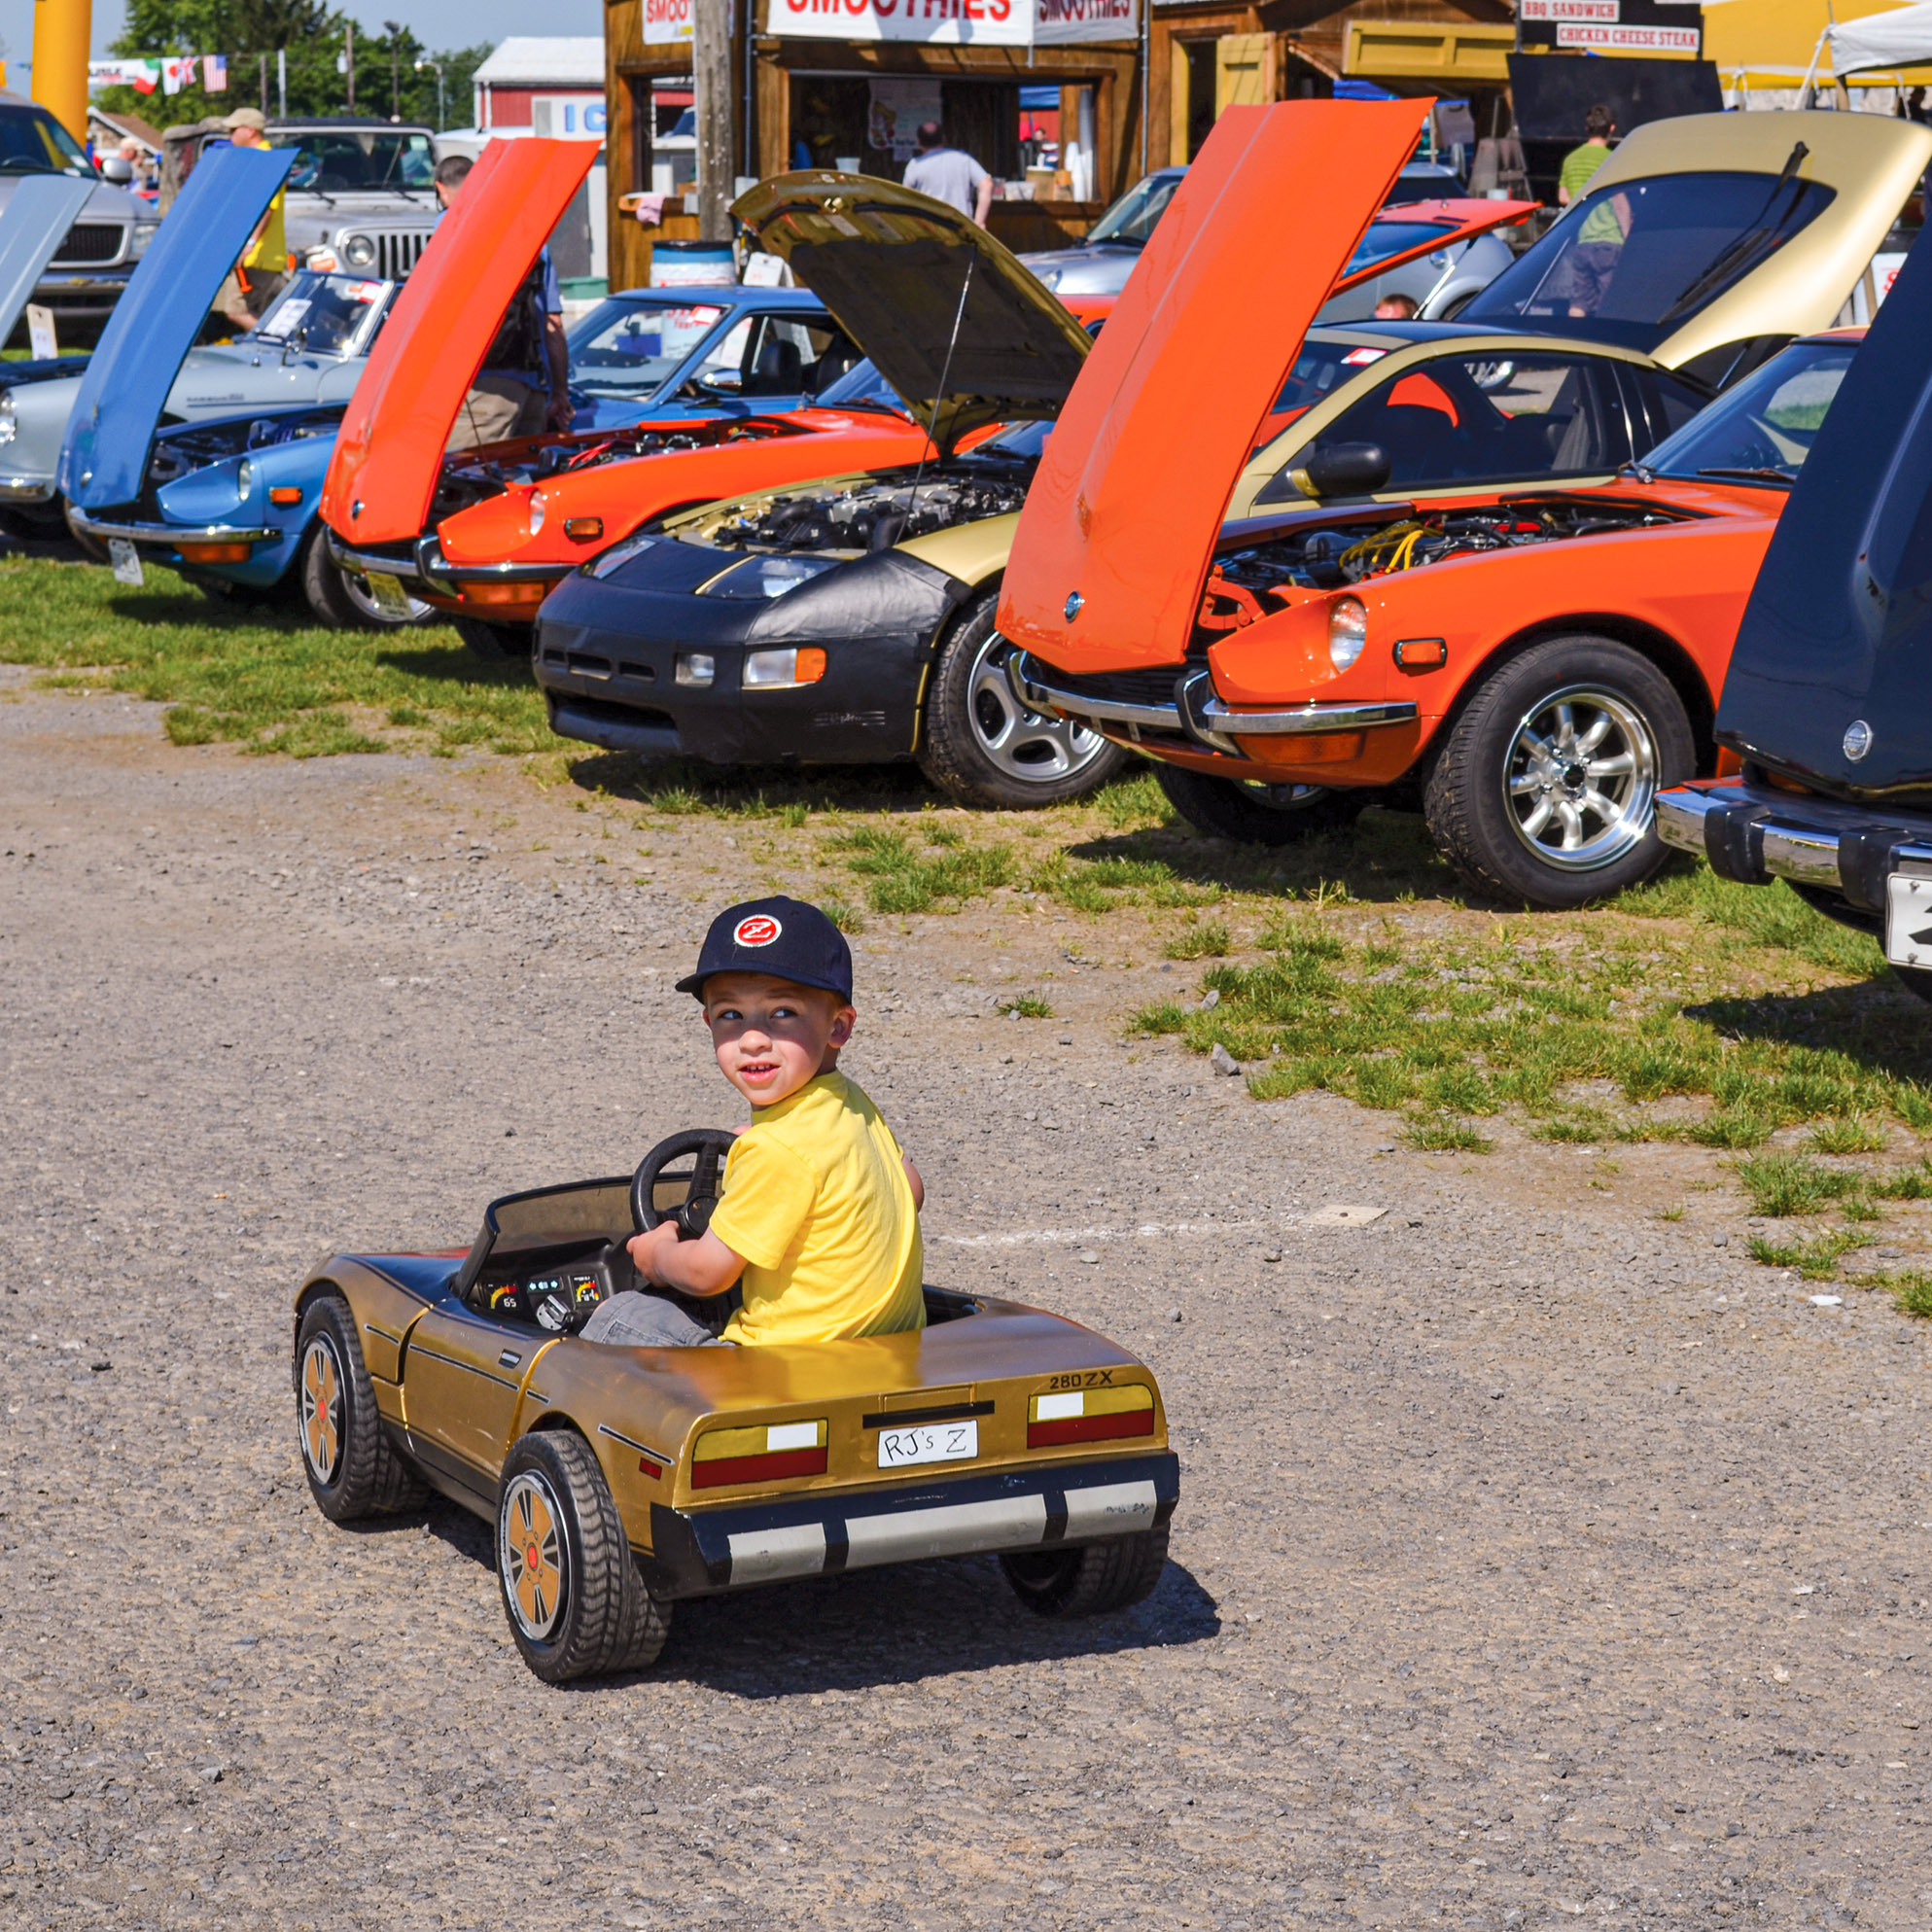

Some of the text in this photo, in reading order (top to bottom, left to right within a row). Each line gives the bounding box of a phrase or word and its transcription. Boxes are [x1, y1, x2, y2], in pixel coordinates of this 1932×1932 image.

[1525, 1, 1615, 18] BBQ SANDWICH
[1559, 27, 1697, 47] CHICKEN CHEESE STEAK
[504, 1298, 517, 1308] 65
[884, 1426, 967, 1461] RJ's Z
